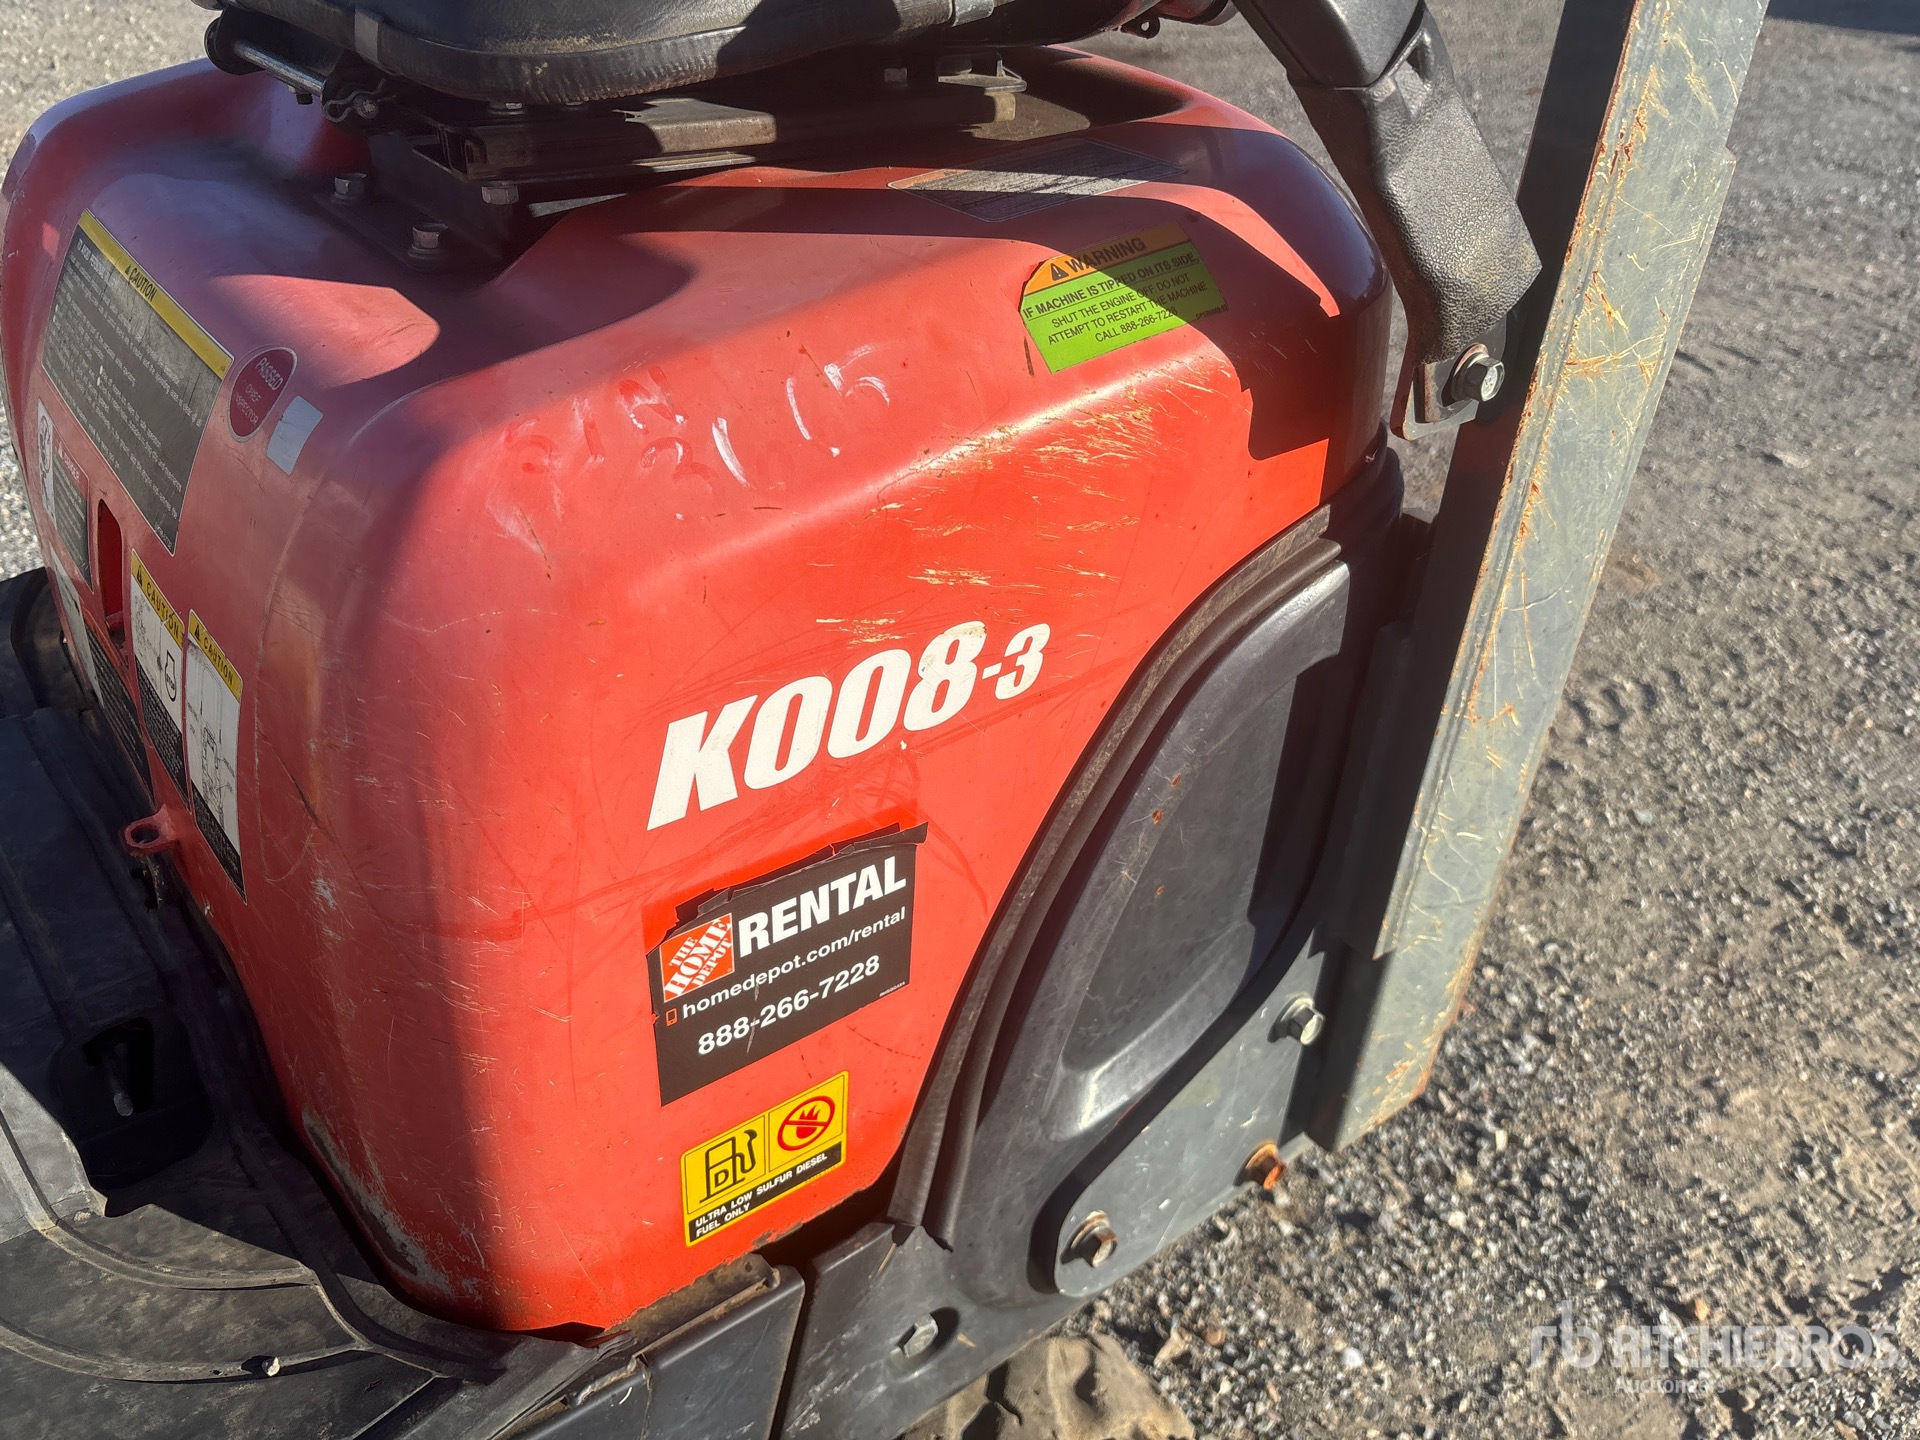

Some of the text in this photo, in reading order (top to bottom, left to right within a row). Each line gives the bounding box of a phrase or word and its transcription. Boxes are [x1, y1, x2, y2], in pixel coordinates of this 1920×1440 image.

[1065, 238, 1147, 273] WARNING
[129, 267, 158, 302] CAUTION
[1023, 307, 1034, 319] IF
[1035, 289, 1087, 314] MACHINE
[1086, 284, 1099, 297] IS
[1097, 272, 1136, 293] TIPPED
[1138, 265, 1154, 280] ON
[1154, 260, 1172, 274] ITS
[1051, 311, 1080, 328] SHUT
[1079, 304, 1100, 319] THE
[1099, 292, 1137, 311] ENGINE
[1157, 279, 1171, 292] DO
[1171, 273, 1190, 286] NOT
[1048, 281, 1208, 345] ATTEMPT TO RESTART THE MACHINE
[1095, 328, 1120, 342] CALL
[1119, 306, 1178, 334] 888-266-7228
[255, 357, 284, 391] PASSED
[146, 582, 179, 639] CAUTION
[203, 637, 233, 686] CAUTION
[646, 620, 1051, 832] K008-3
[738, 855, 907, 958] RENTAL
[663, 917, 733, 995] HOME
[668, 936, 699, 967] THE
[682, 906, 906, 1019] homedepot.com/rental
[691, 937, 732, 986] DEPOT
[698, 954, 880, 1055] 888-266-7228
[695, 1205, 728, 1228] ULTRA
[730, 1190, 753, 1210] LOW
[756, 1169, 793, 1196] SULFUR
[796, 1152, 828, 1175] DIESEL
[695, 1202, 750, 1238] FUEL ONLY
